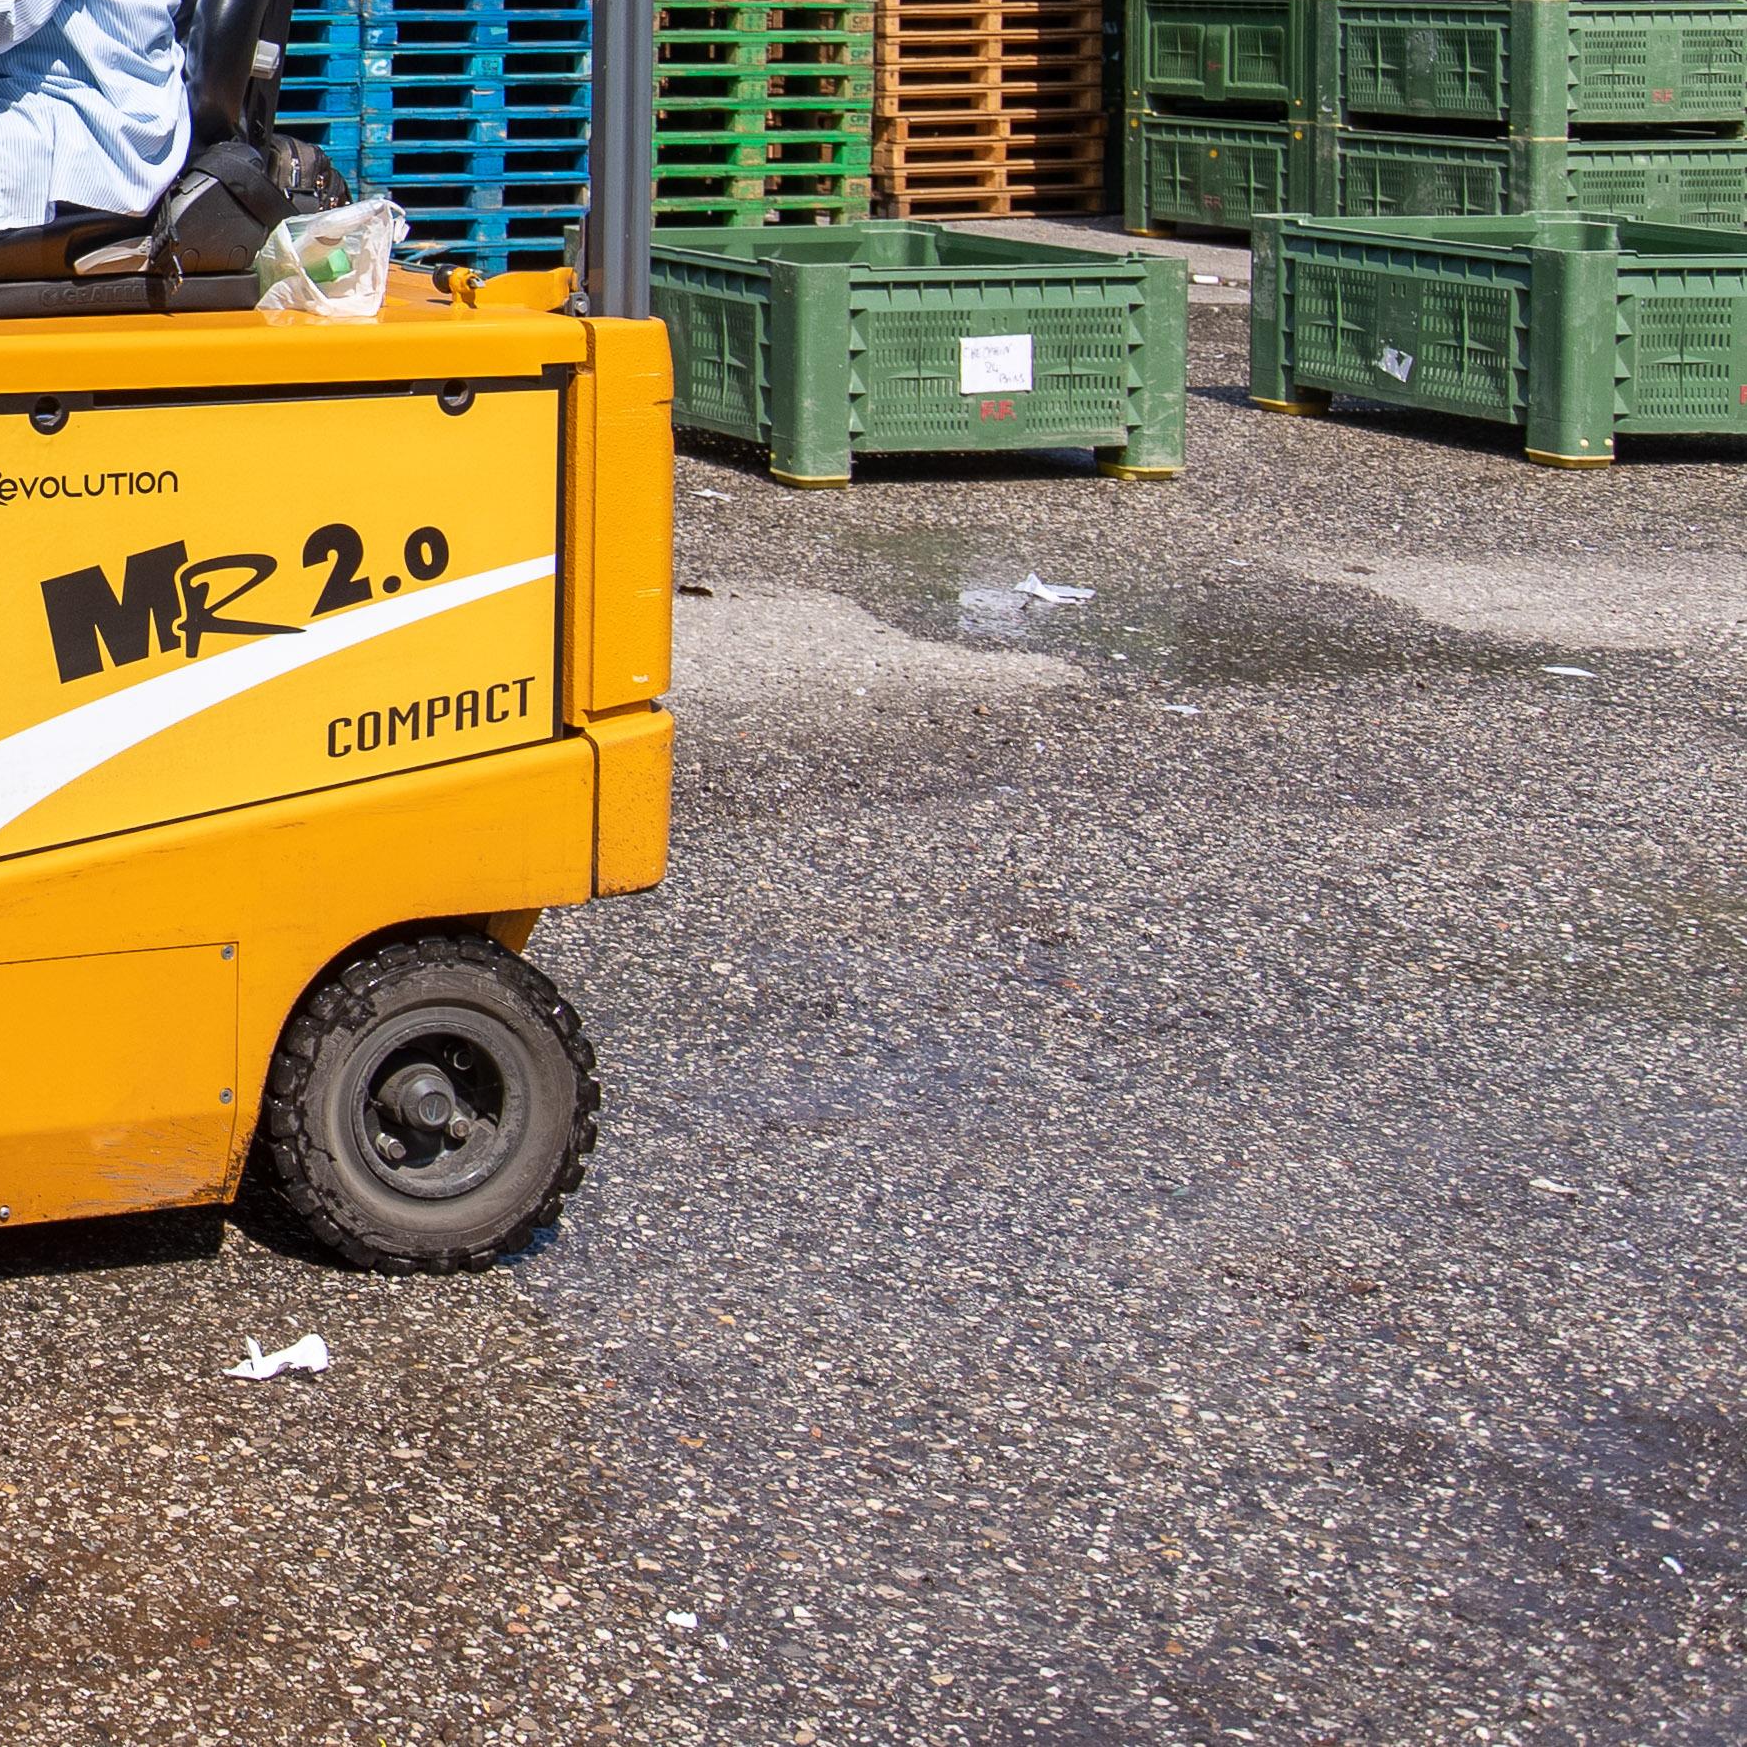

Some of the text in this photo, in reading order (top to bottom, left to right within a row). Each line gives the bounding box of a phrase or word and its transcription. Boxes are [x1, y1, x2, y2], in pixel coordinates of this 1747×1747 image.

[41, 523, 450, 684] MR 2.0
[327, 676, 536, 759] COMPACT
